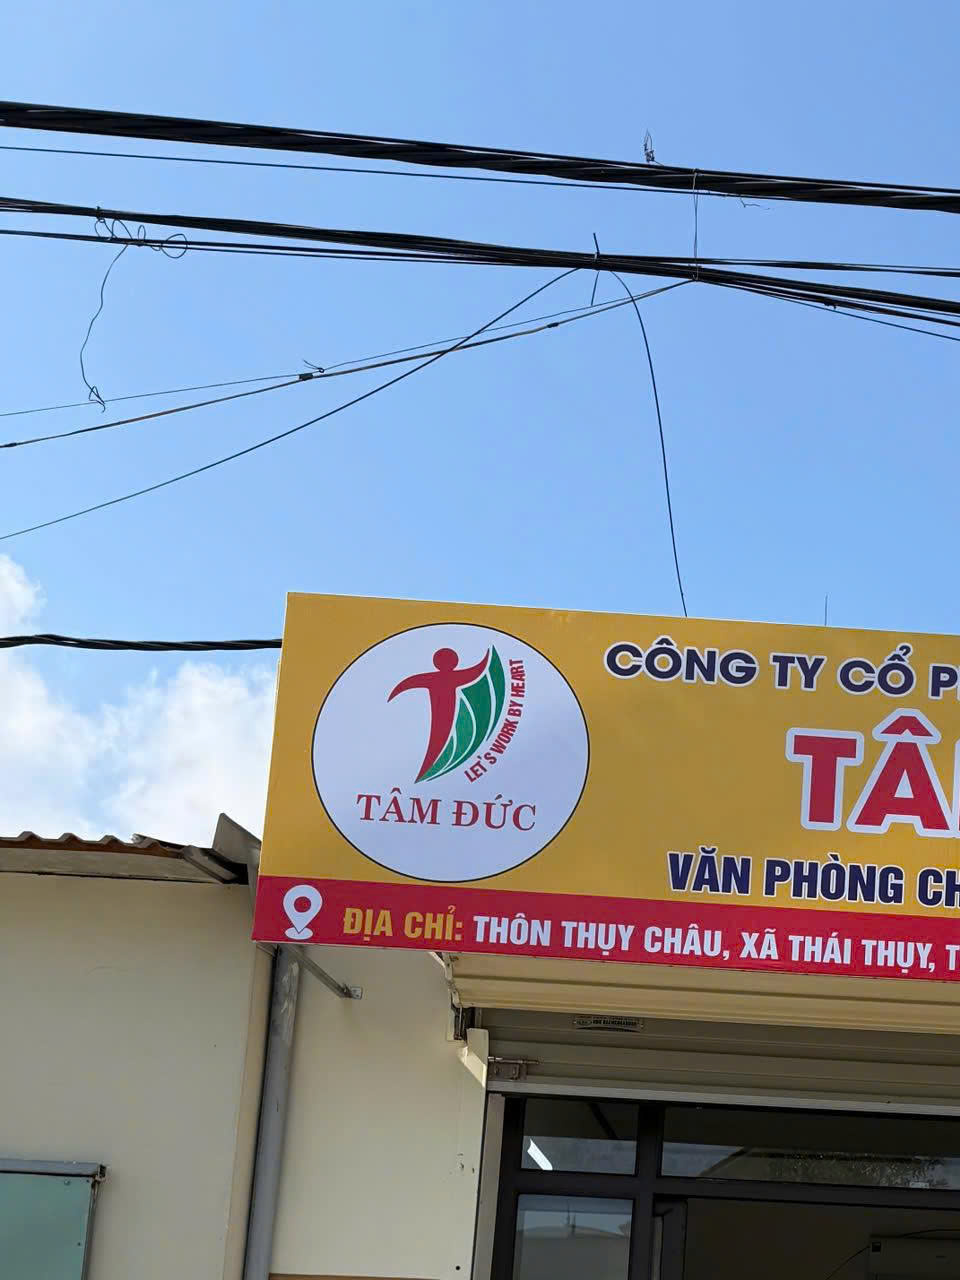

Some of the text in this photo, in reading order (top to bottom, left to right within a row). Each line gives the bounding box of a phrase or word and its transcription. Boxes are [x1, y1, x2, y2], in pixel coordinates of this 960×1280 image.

[604, 637, 757, 685] CÔNG
[771, 653, 824, 691] TY
[838, 643, 915, 697] CỔ
[464, 659, 526, 783] LET'S WORK BY HEART
[355, 788, 537, 832] TÂM ĐỨC
[668, 846, 753, 897] VĂN
[763, 852, 905, 905] PHÒNG
[343, 908, 398, 942] ĐỊA
[403, 905, 463, 943] CHỈ:
[473, 911, 558, 948] THÔN
[561, 921, 637, 957] THỤY
[643, 921, 731, 961] CHÂU,
[739, 929, 781, 962] XÃ
[787, 930, 853, 965] THÁI
[860, 938, 936, 974] THỤY,
